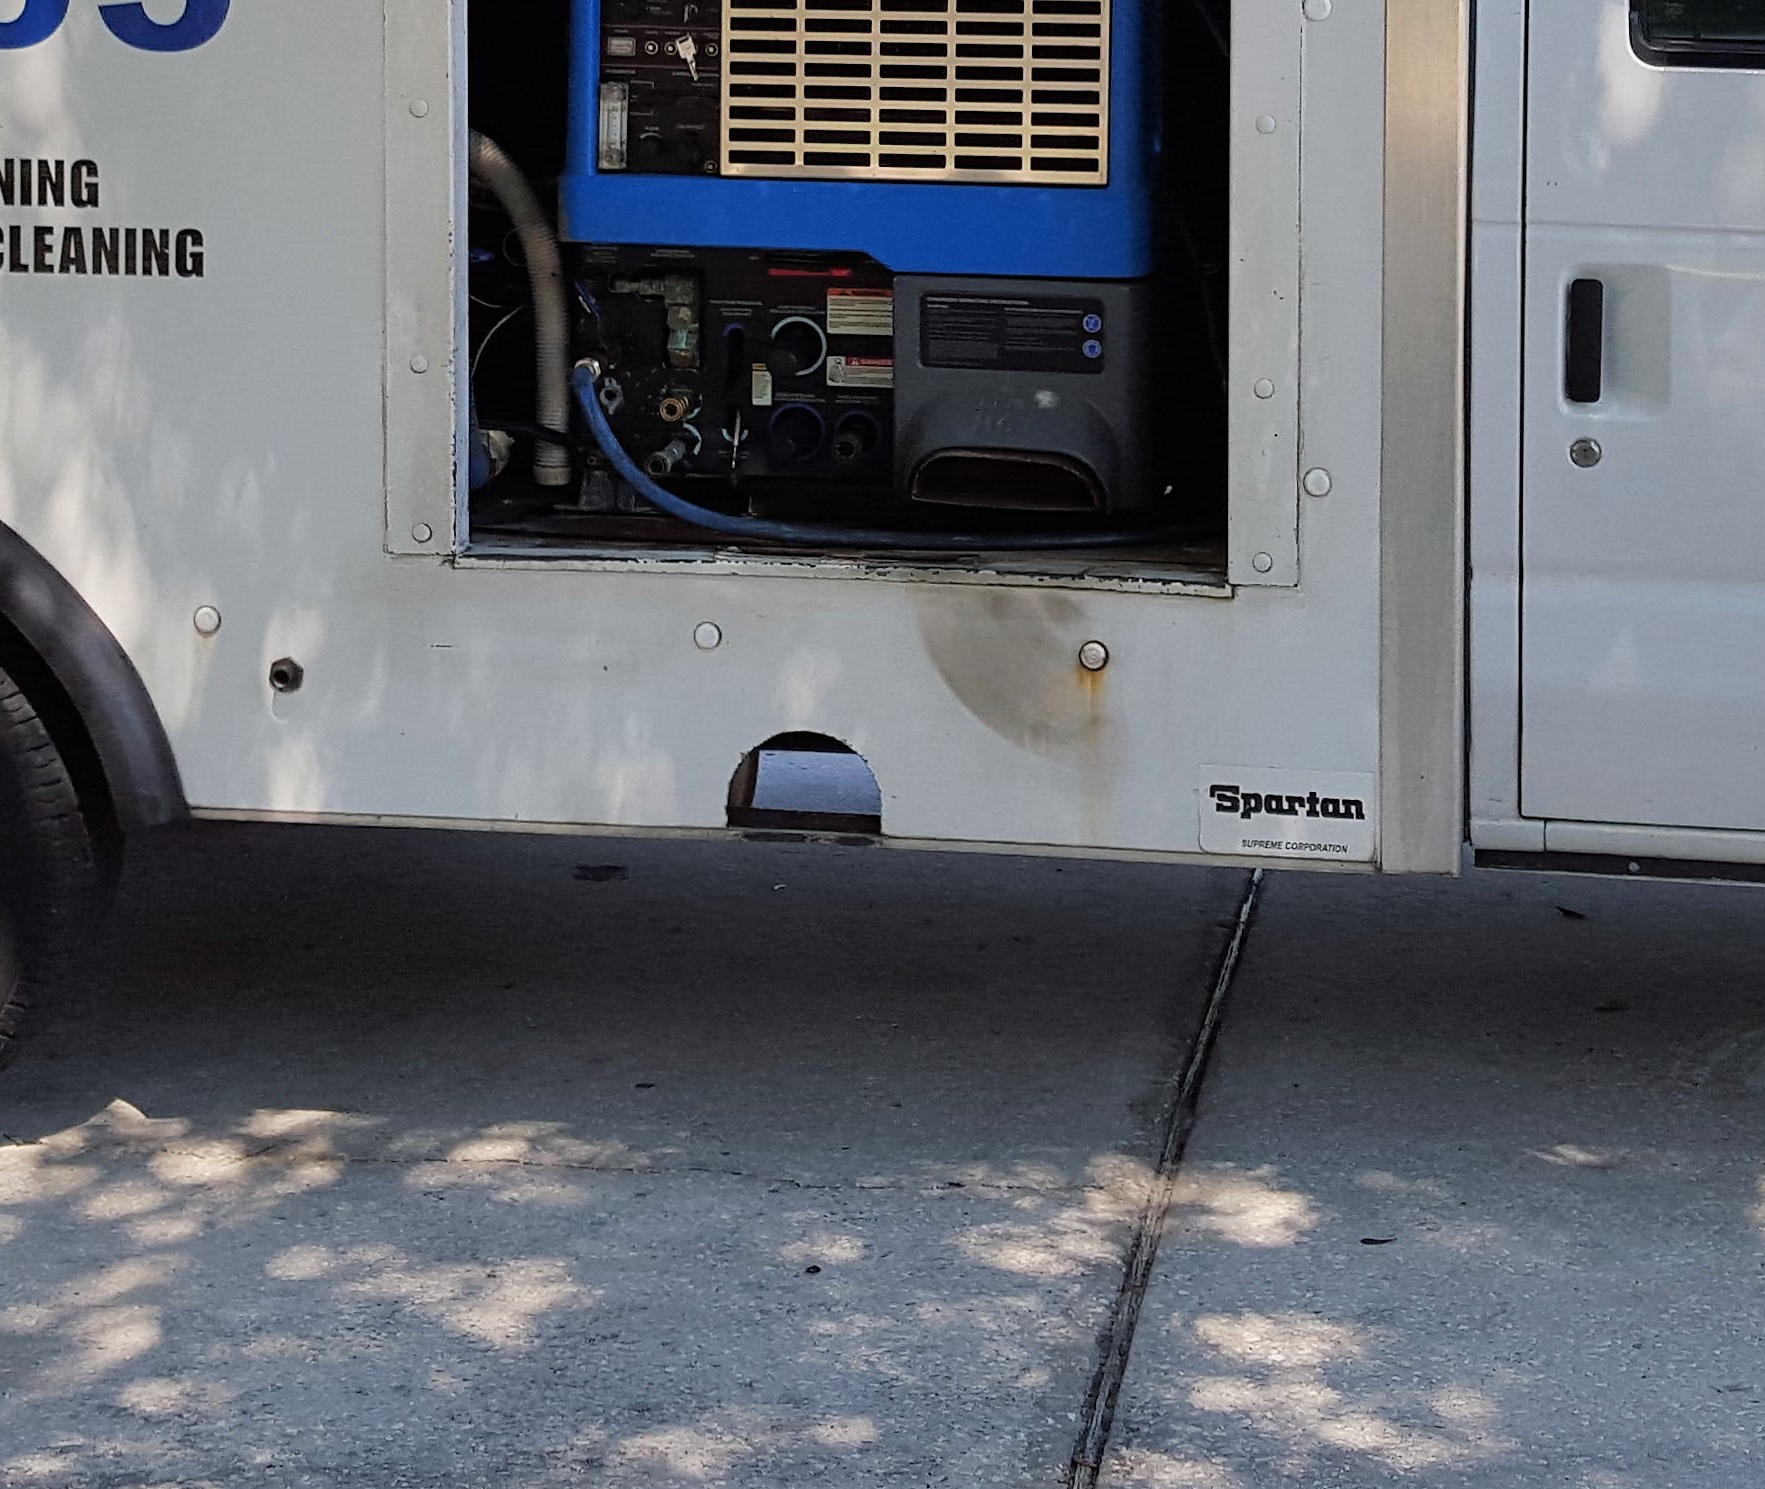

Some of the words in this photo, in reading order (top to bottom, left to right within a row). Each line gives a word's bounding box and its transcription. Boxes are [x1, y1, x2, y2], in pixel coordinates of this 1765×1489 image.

[1209, 784, 1365, 820] Spartan
[1242, 839, 1283, 850] SUPREME
[1285, 842, 1348, 853] CORPORATION
